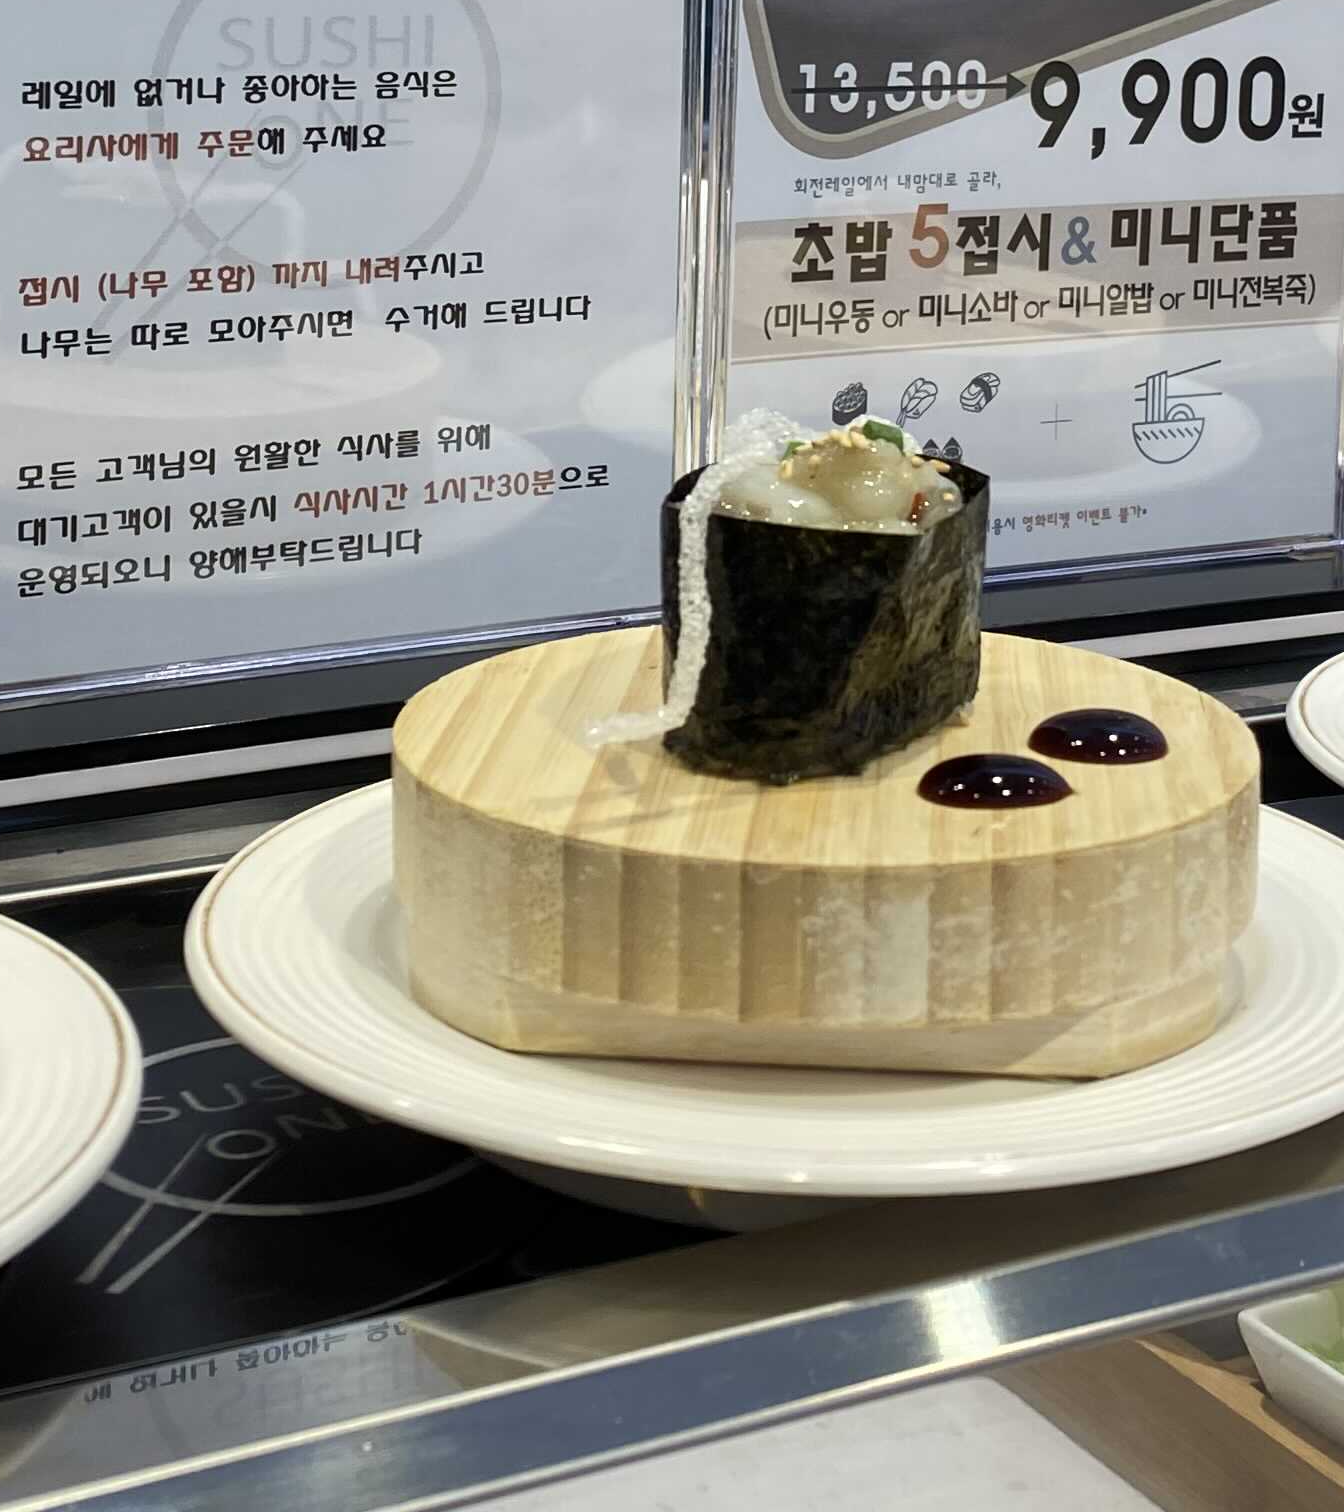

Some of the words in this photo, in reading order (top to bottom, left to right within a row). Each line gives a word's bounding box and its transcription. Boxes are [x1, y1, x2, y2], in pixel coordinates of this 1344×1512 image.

[21, 79, 116, 110] 레일에
[134, 77, 226, 107] 없거나
[241, 73, 358, 105] 좋아하는
[374, 69, 458, 100] 음식은
[798, 58, 988, 119] 13,500
[1028, 55, 1325, 161] 9,900원
[23, 132, 178, 164] 요리사에게
[197, 127, 285, 159] 주문해
[302, 123, 387, 154] 주세요
[793, 174, 888, 199] 회전레일에서
[897, 172, 958, 195] 내맘대로
[966, 170, 1001, 193] 골라,
[790, 219, 892, 283] 초밥
[1110, 201, 1298, 267] 미니단품
[18, 274, 80, 307] 접시
[98, 269, 169, 302] (나무
[186, 264, 255, 294] 포함)
[271, 260, 328, 290] 까지
[345, 251, 485, 285] 내려주시고
[763, 298, 875, 341] (미니우동
[882, 305, 909, 330] or
[918, 289, 1018, 327] 미니소바
[1024, 297, 1051, 320] or
[1057, 282, 1155, 318] 미니알밥
[1159, 288, 1187, 312] or
[1192, 272, 1316, 311] 미니전복죽)
[21, 327, 113, 360] 나무는
[130, 321, 190, 351] 따로
[207, 309, 353, 344] 모아주시면
[384, 302, 467, 333] 수거해
[483, 294, 592, 325] 드립니다
[15, 460, 77, 491] 모든
[95, 447, 216, 483] 고객님의
[233, 438, 322, 473] 원활한
[336, 429, 421, 462] 식사를
[437, 423, 491, 454] 위해
[17, 505, 171, 547] 대기고객이
[189, 494, 277, 531] 있을시
[293, 482, 409, 519] 식사시간
[424, 464, 610, 505] 1시간30분으로
[17, 554, 171, 598] 운영되오니
[188, 528, 423, 580] 양해부탁드립니다
